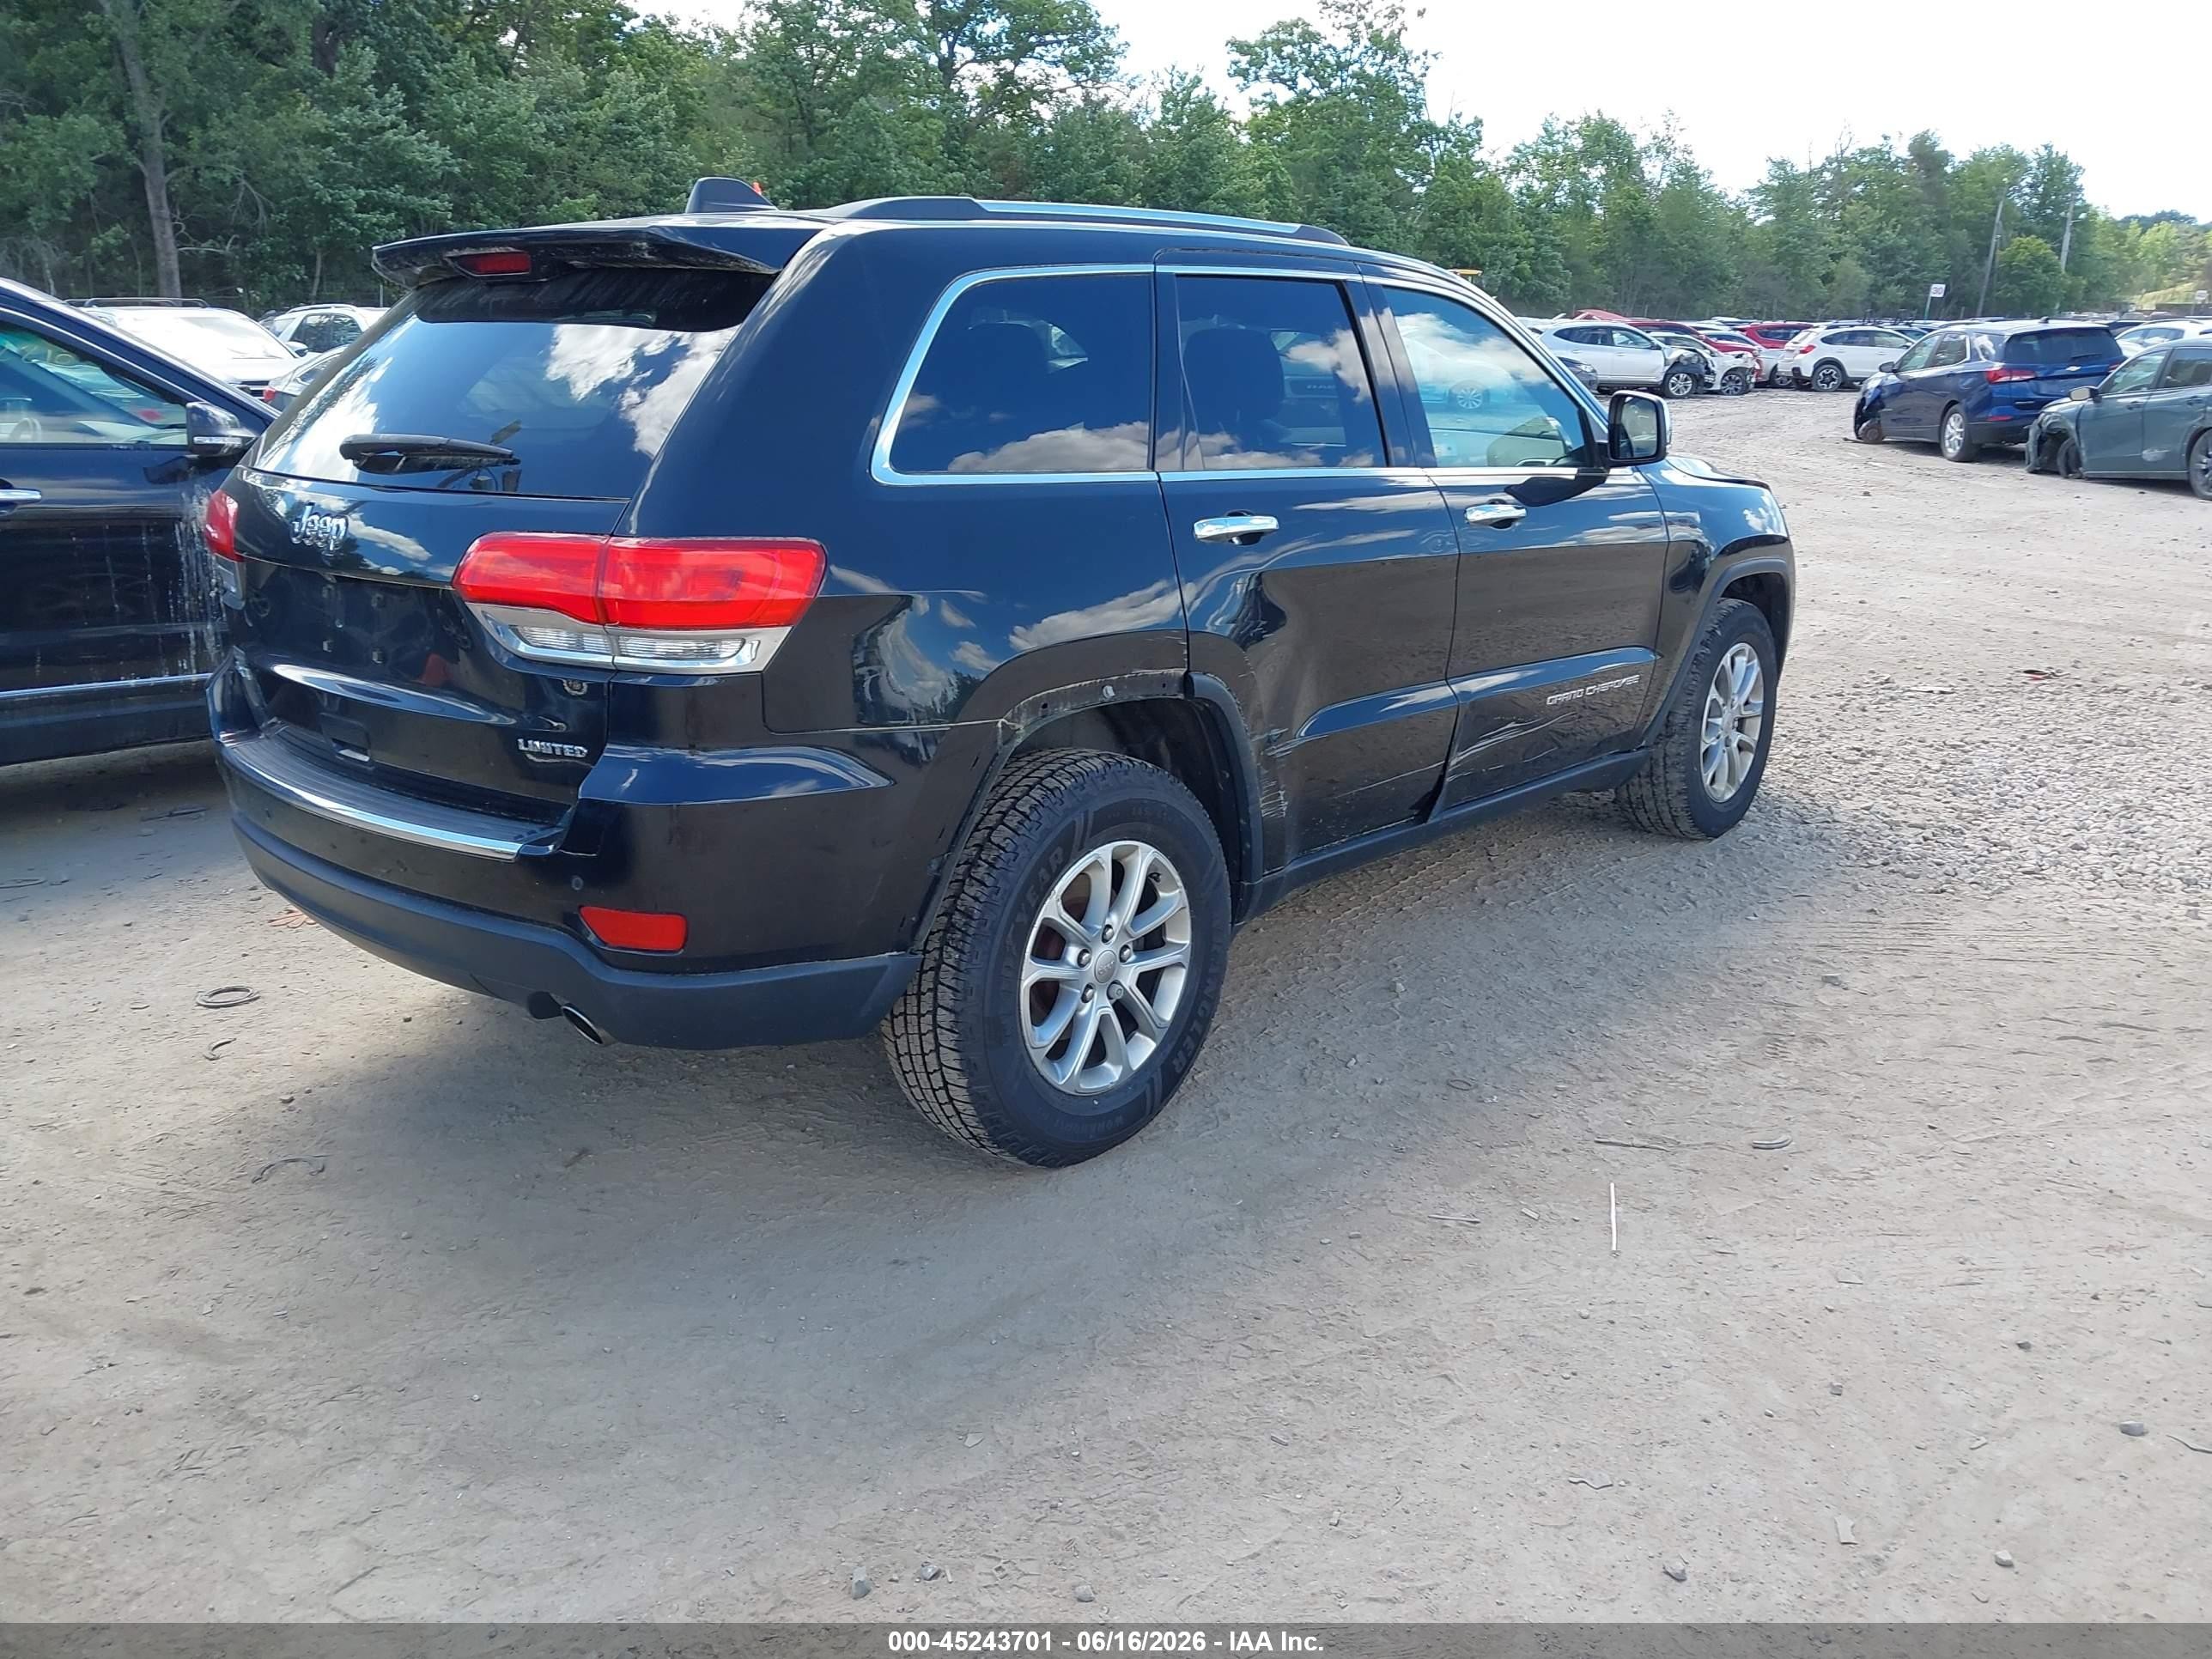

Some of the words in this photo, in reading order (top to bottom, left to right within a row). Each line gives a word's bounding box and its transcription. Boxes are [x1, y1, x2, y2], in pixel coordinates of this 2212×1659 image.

[290, 505, 347, 550] Jeep
[1546, 688, 1584, 705] GRAND
[517, 738, 588, 758] LIMITED
